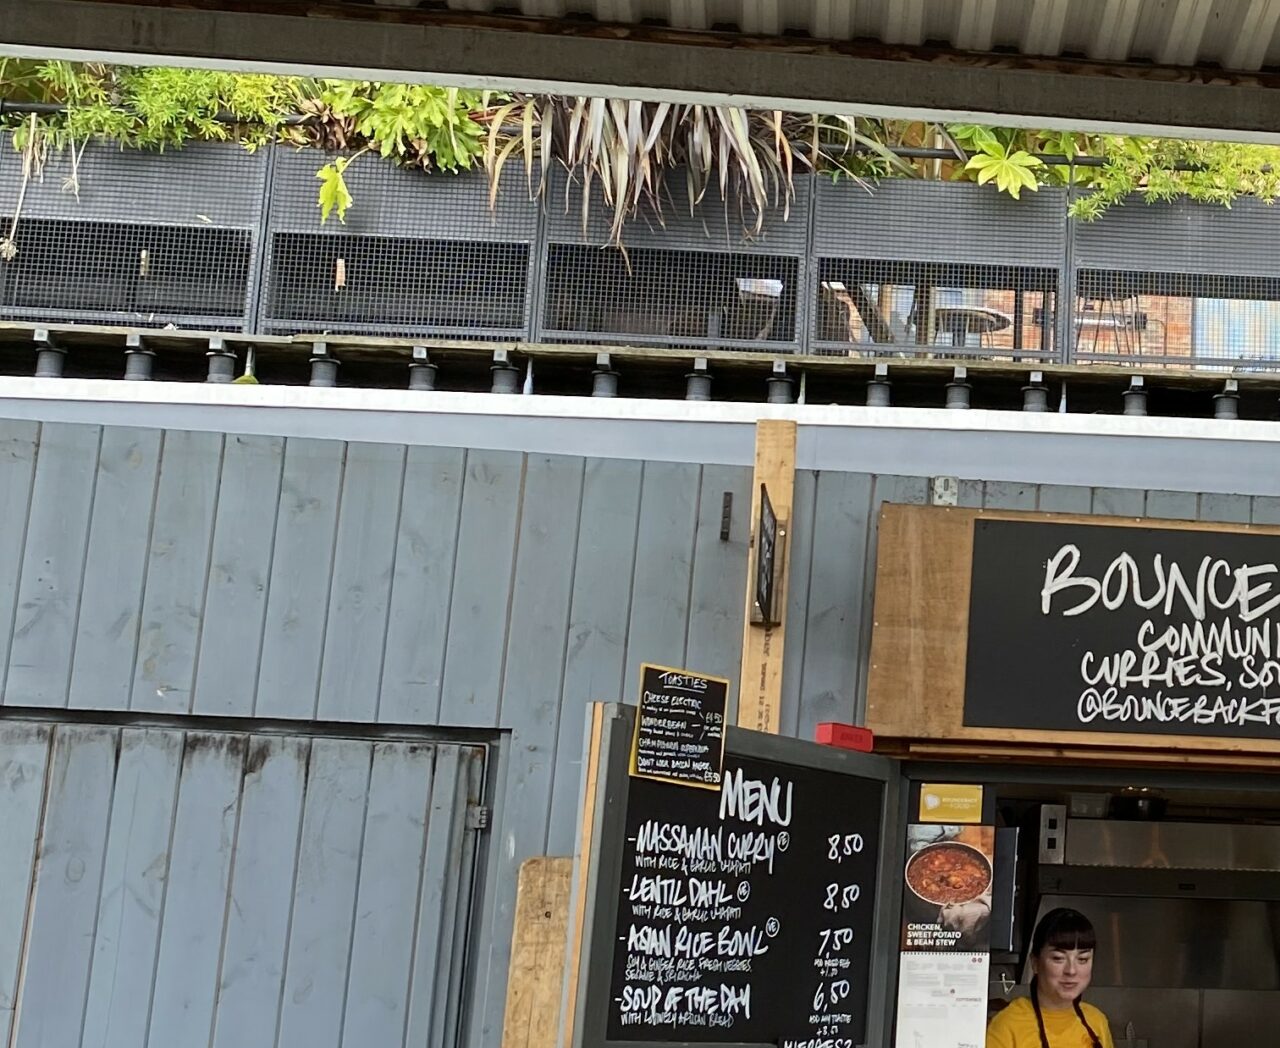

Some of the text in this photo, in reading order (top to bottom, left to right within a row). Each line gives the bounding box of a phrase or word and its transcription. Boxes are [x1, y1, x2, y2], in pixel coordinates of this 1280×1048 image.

[1081, 651, 1231, 691] CURRIES,
[719, 768, 793, 827] MENU
[635, 855, 656, 869] WITH
[658, 855, 680, 870] RICE
[727, 832, 775, 874] CURRY
[689, 877, 733, 908] DAHL
[675, 925, 716, 958] RICE
[717, 925, 768, 956] BOWL
[907, 931, 962, 939] SWEET POTATO
[664, 986, 684, 1012] OF
[685, 986, 719, 1014] THE
[720, 983, 750, 1019] DAY
